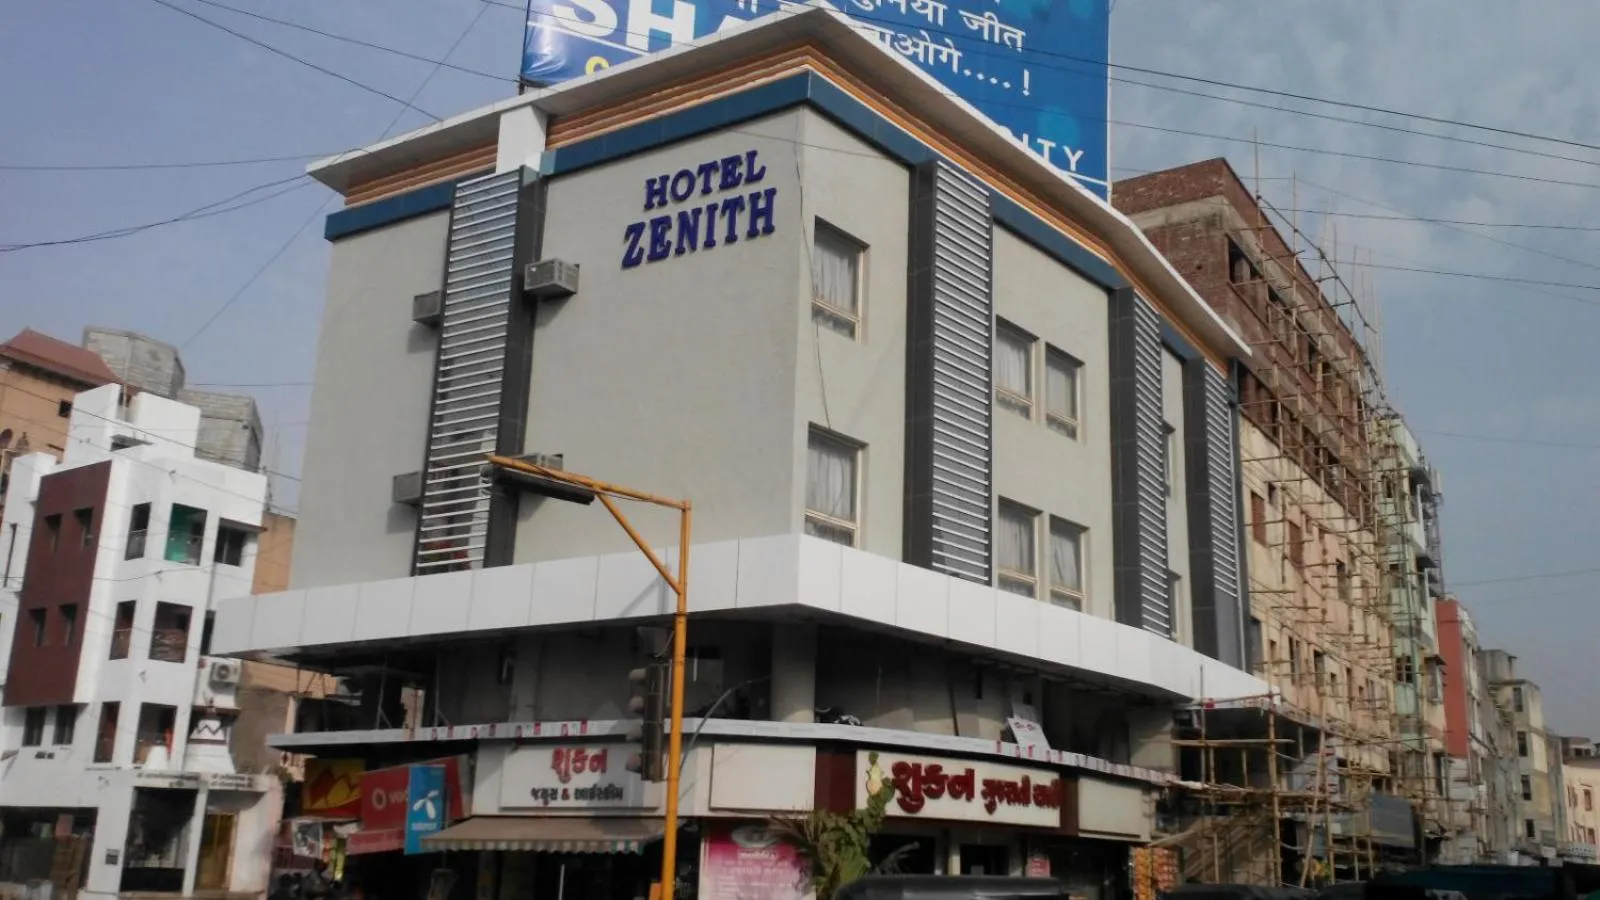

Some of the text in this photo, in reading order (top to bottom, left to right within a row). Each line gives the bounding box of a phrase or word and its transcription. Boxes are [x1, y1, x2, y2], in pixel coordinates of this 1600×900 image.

[958, 11, 1027, 53] जीत
[643, 150, 767, 211] HOTEL
[621, 187, 777, 269] ZENITH
[892, 761, 975, 814] શુકન
